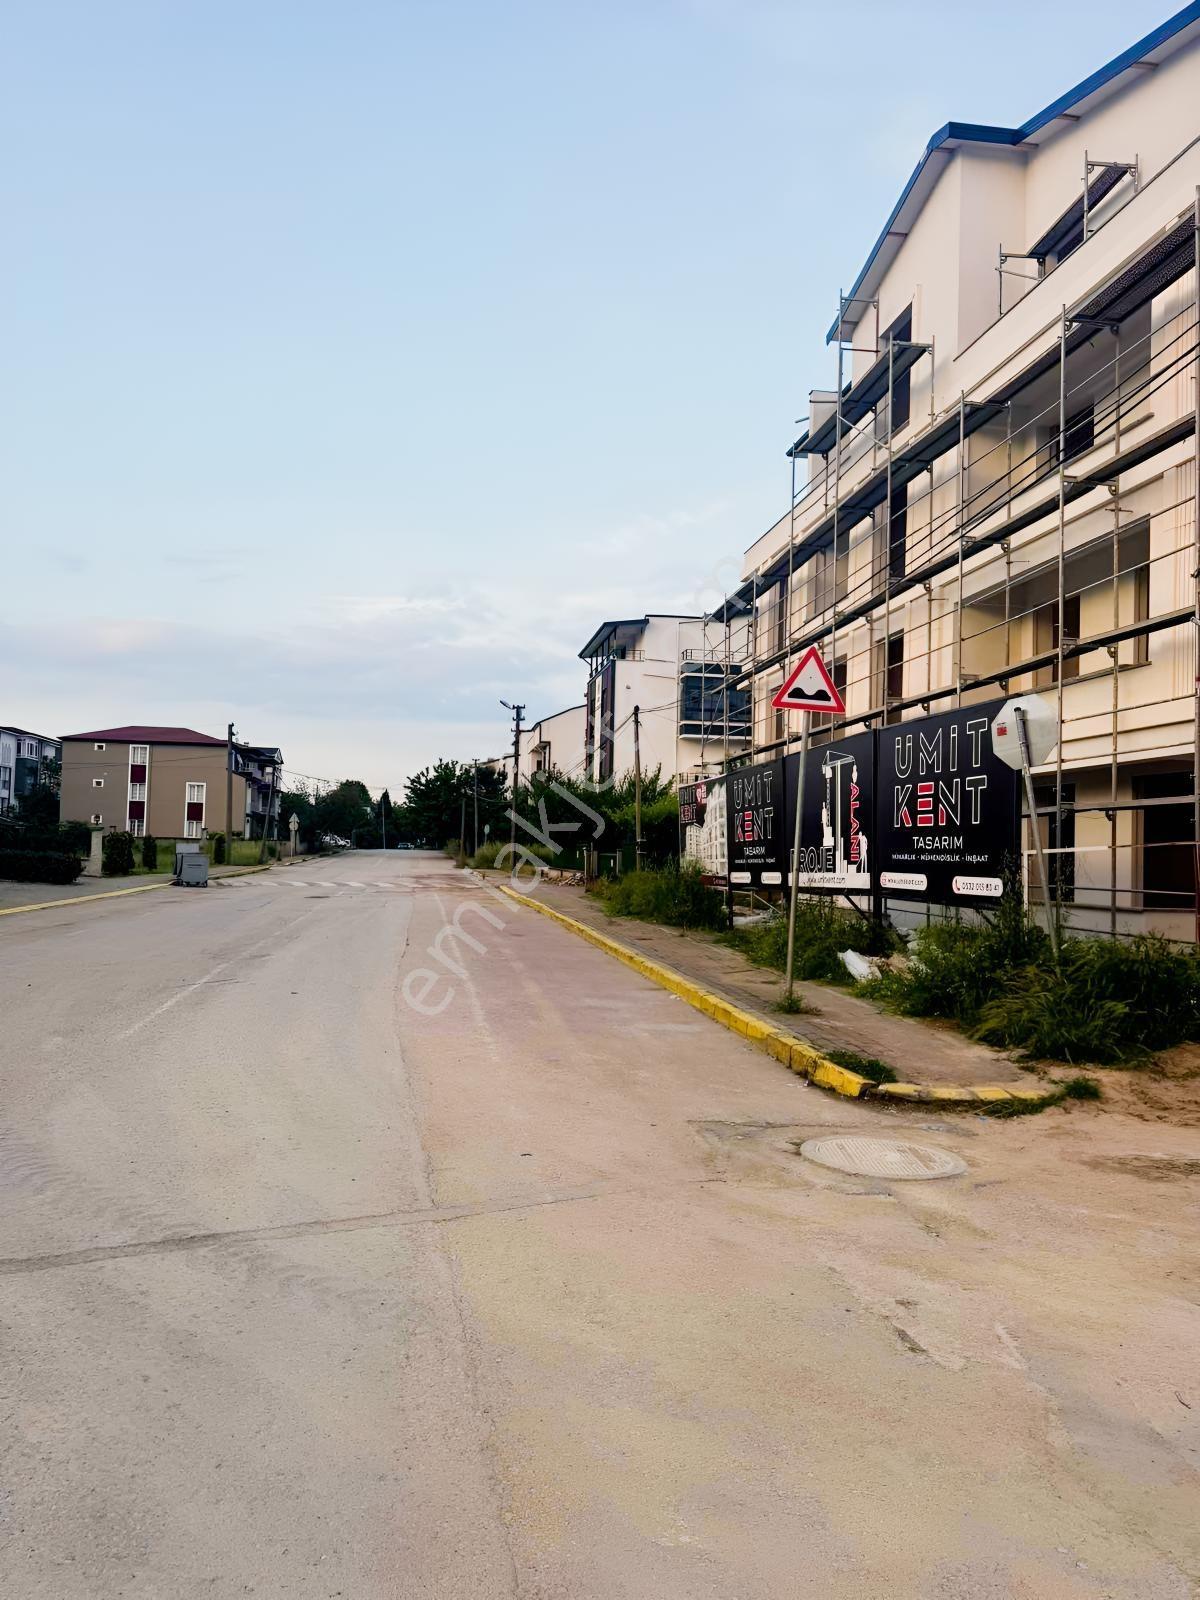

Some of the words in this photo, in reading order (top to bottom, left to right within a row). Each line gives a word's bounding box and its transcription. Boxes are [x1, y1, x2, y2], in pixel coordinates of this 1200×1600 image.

[893, 775, 988, 828] KENT
[734, 807, 774, 842] KENT
[912, 835, 964, 850] TASARIM
